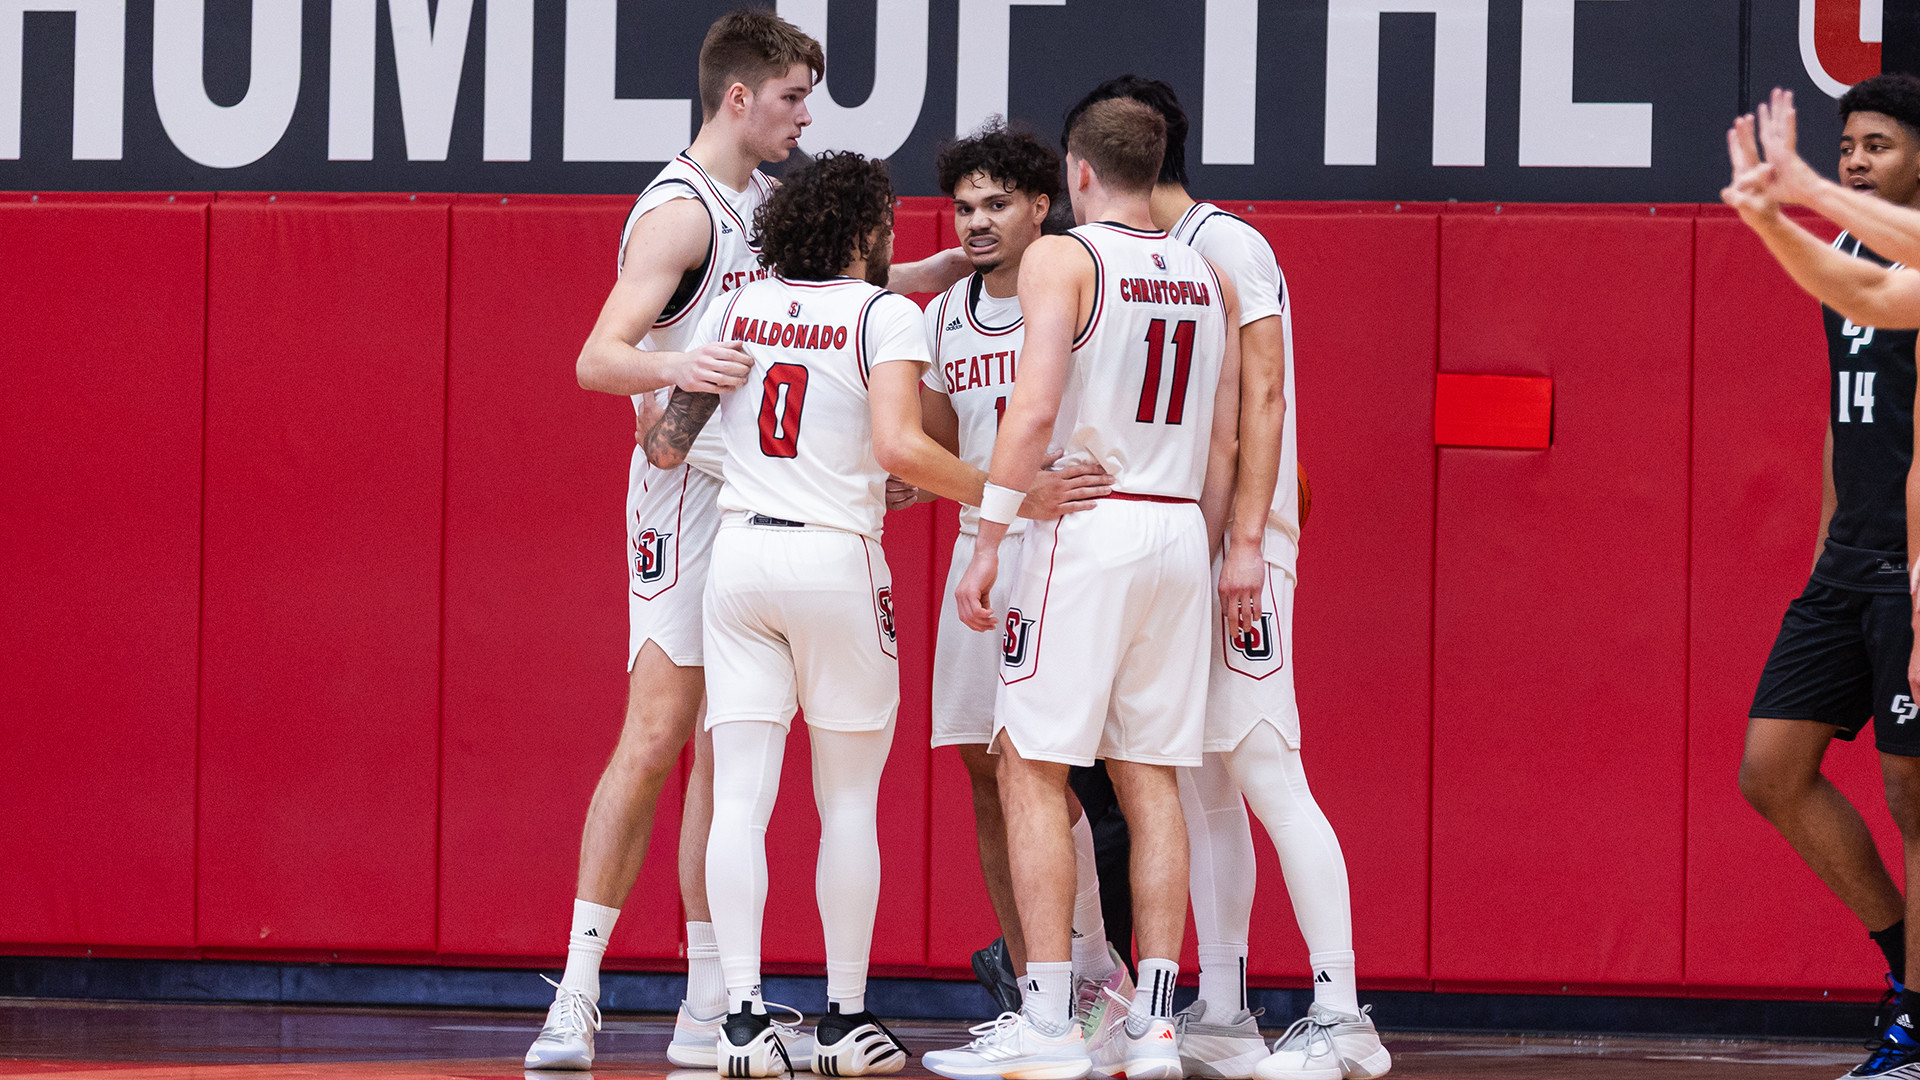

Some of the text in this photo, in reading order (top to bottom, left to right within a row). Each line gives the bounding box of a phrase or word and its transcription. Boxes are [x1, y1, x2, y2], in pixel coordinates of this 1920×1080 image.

[1120, 278, 1210, 307] CHRISTOFILIS
[731, 316, 848, 350] MALDONADO
[1136, 318, 1197, 425] 11
[1839, 371, 1877, 423] 14
[758, 362, 808, 459] 0
